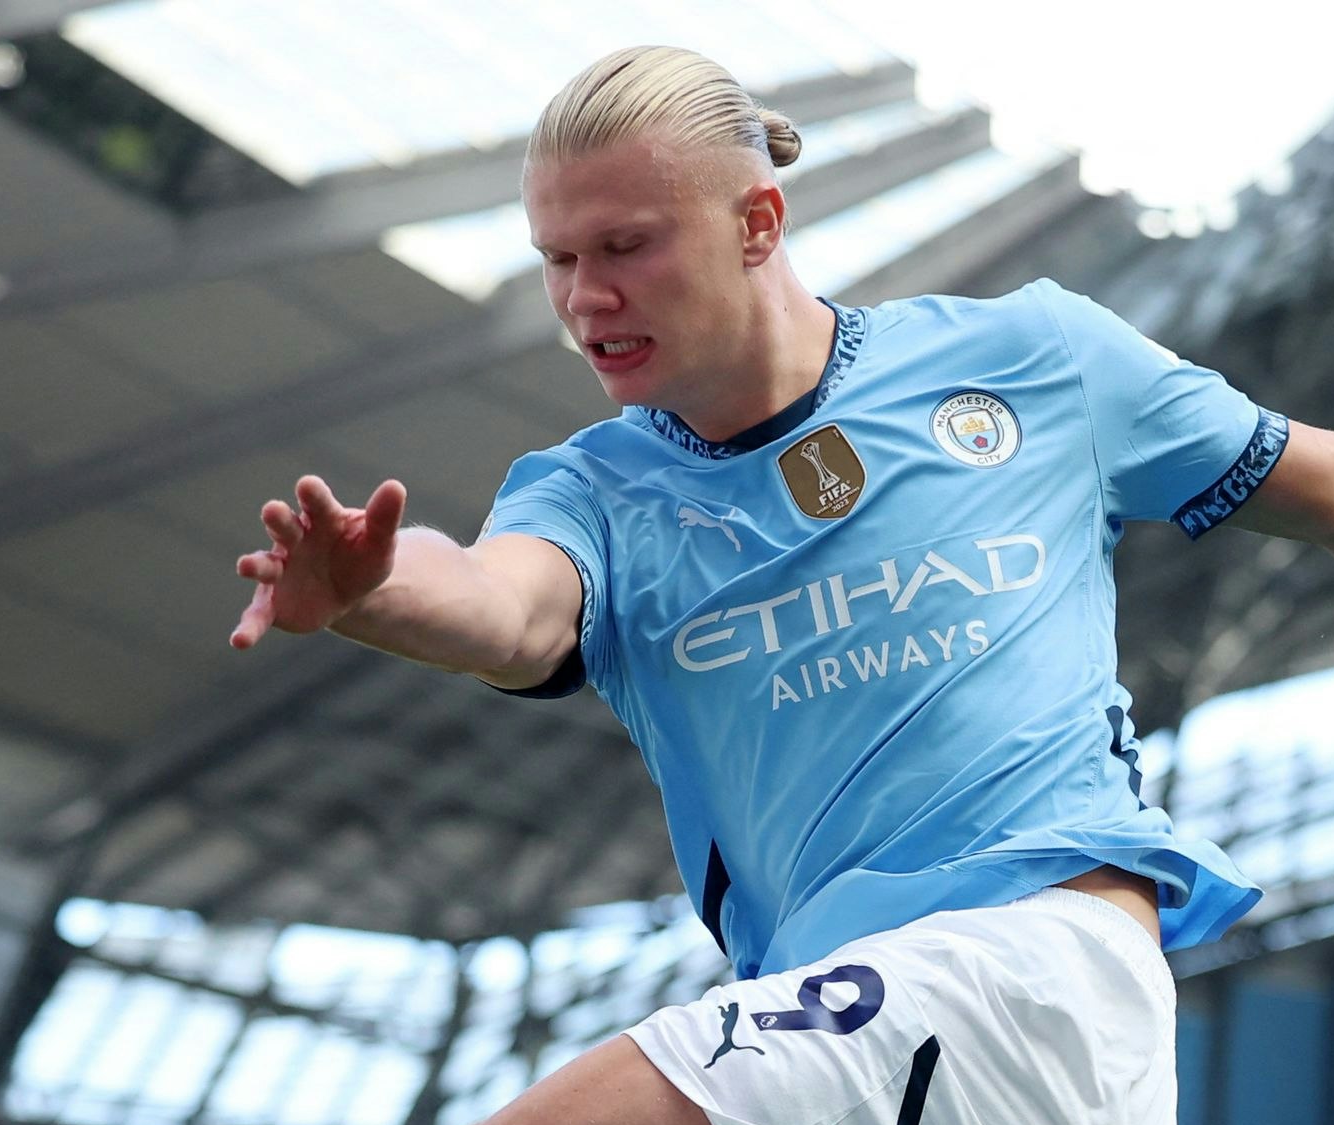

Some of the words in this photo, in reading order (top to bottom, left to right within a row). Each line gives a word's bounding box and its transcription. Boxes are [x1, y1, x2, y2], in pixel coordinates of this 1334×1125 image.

[937, 396, 1003, 428] MANCHESTER
[977, 454, 1001, 464] CITY
[818, 482, 851, 506] FIFA
[672, 534, 1046, 672] ETIHAD
[771, 619, 990, 710] AIRWAYS
[750, 964, 885, 1035] 9
